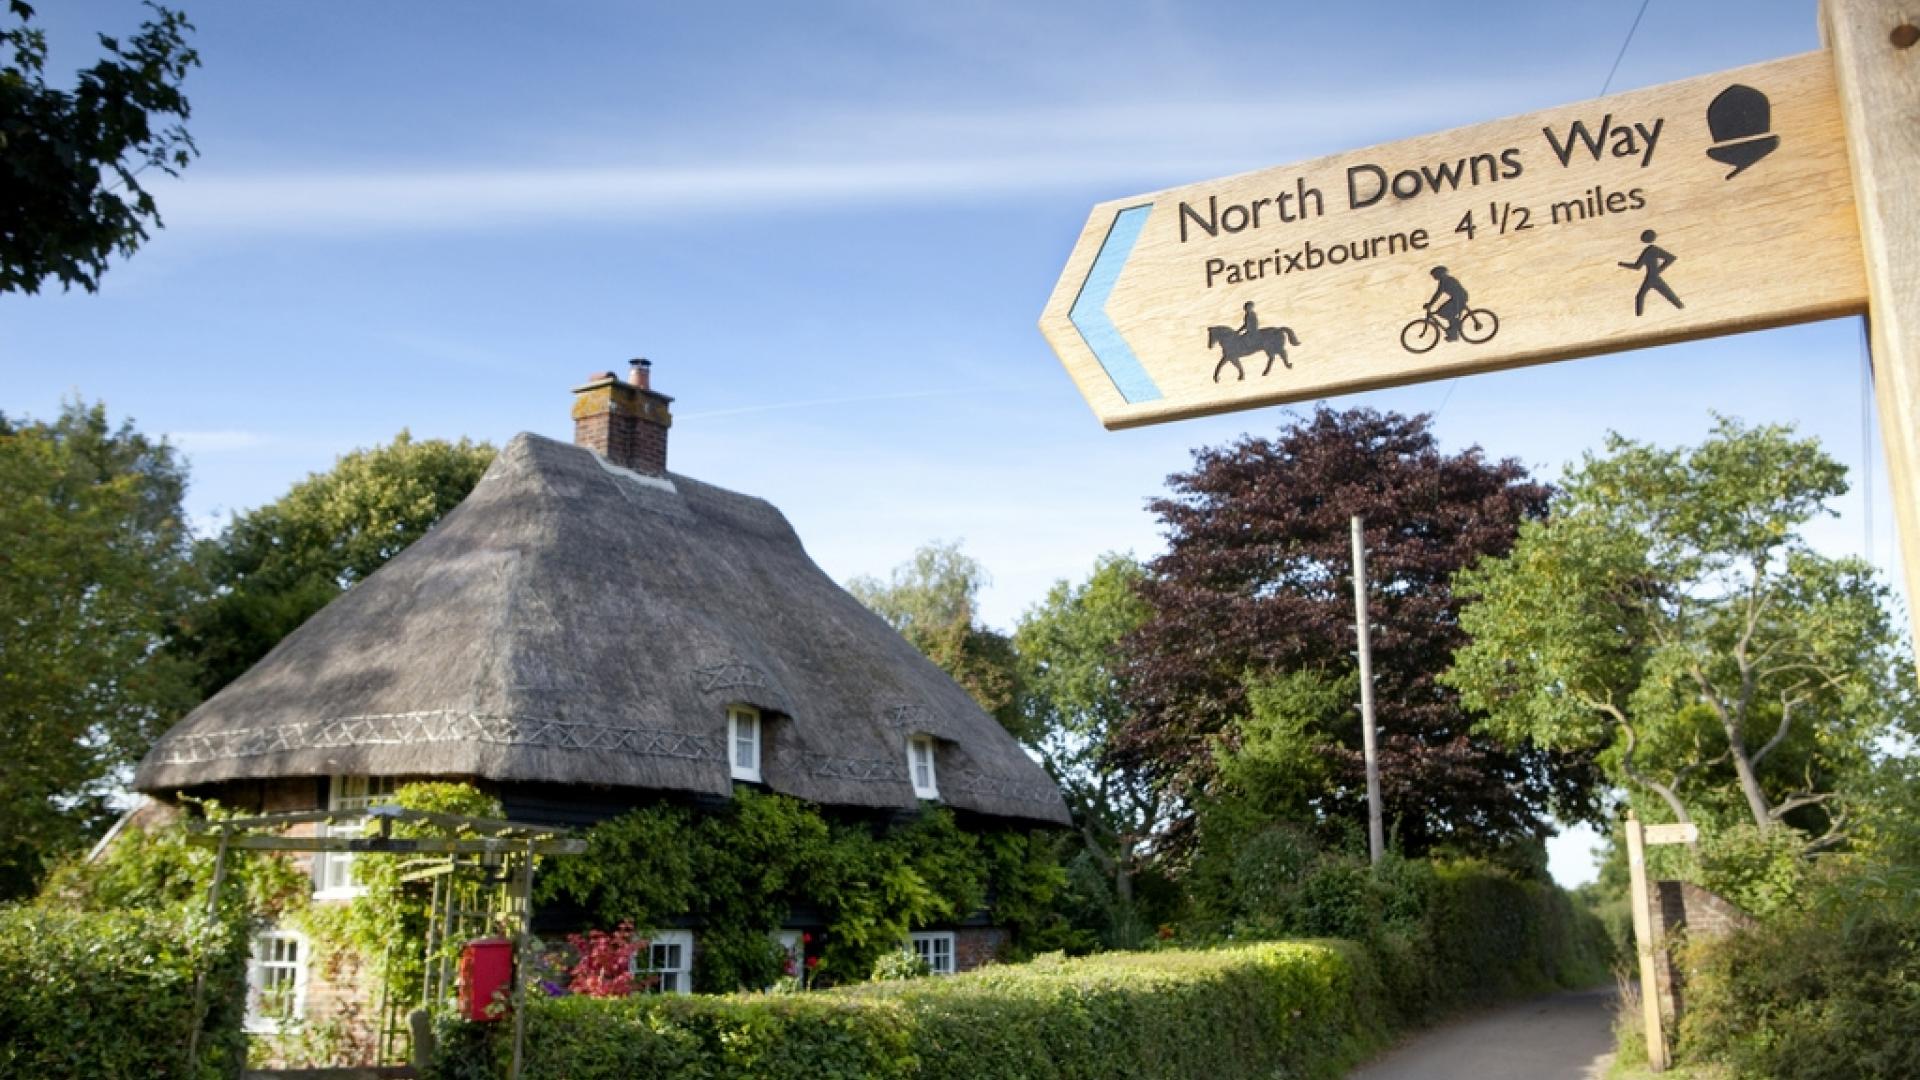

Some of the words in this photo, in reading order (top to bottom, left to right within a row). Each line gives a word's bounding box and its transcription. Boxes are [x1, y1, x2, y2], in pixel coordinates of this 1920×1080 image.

[1179, 177, 1323, 243] North
[1347, 148, 1523, 210] Downs
[1542, 113, 1664, 168] Way
[1206, 229, 1430, 288] Patrixbourne
[1454, 210, 1477, 240] 4
[1551, 185, 1646, 225] miles
